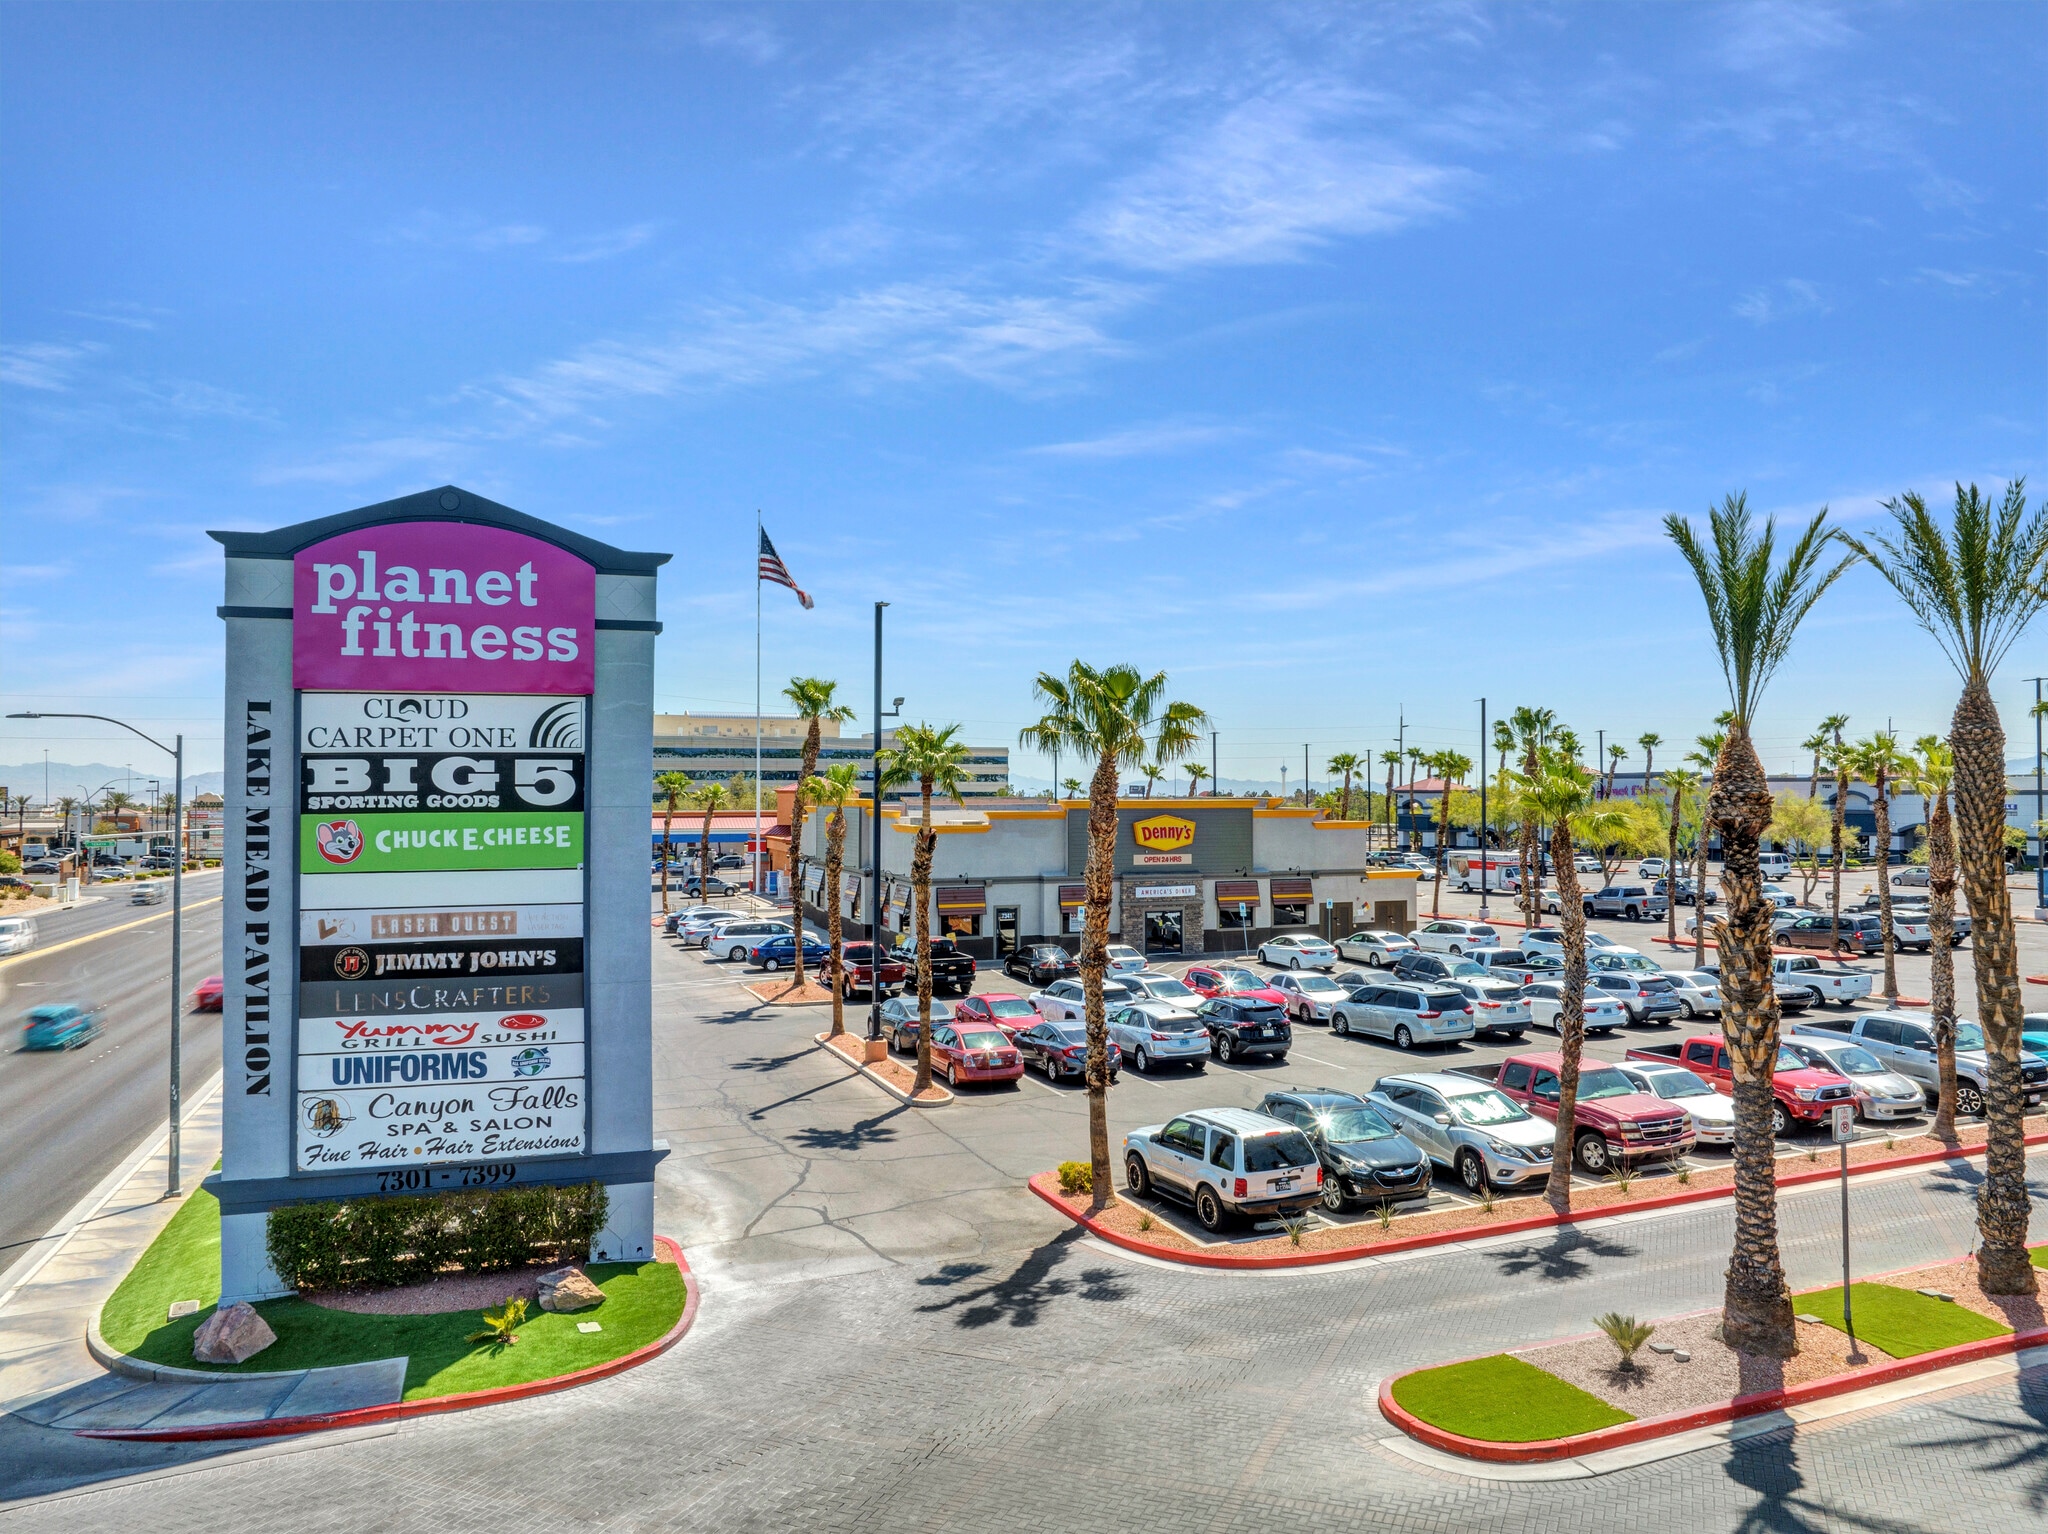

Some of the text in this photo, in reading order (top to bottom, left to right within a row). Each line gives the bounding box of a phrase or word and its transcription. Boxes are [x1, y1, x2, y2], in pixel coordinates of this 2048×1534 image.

[311, 550, 538, 614] planet
[341, 606, 579, 662] fitness
[363, 699, 469, 723] CLOUD
[307, 727, 517, 748] CARPET ONE
[307, 756, 500, 795] BIG
[514, 759, 577, 807] 5
[308, 795, 500, 810] SPORTING GOODS
[375, 829, 459, 853] CHUCK
[483, 825, 571, 848] CHEESE
[1141, 825, 1191, 841] Denny's
[245, 700, 272, 1097] LAKE MEAD PAVILION
[1141, 888, 1172, 896] AMERICA'S
[378, 915, 511, 934] LASER QUEST
[375, 952, 464, 976] JIMMY
[469, 949, 557, 973] JOHN'S
[335, 1020, 479, 1045] Yummy
[341, 1030, 557, 1049] GRILL SUSHI
[332, 1051, 488, 1086] UNIFORMS
[368, 1085, 579, 1122] Canyon Falls
[387, 1116, 553, 1137] SPA & SALON
[304, 1133, 581, 1166] Fine Hair Hair Extensions
[377, 1170, 432, 1192] 7301
[459, 1163, 517, 1186] 7399
